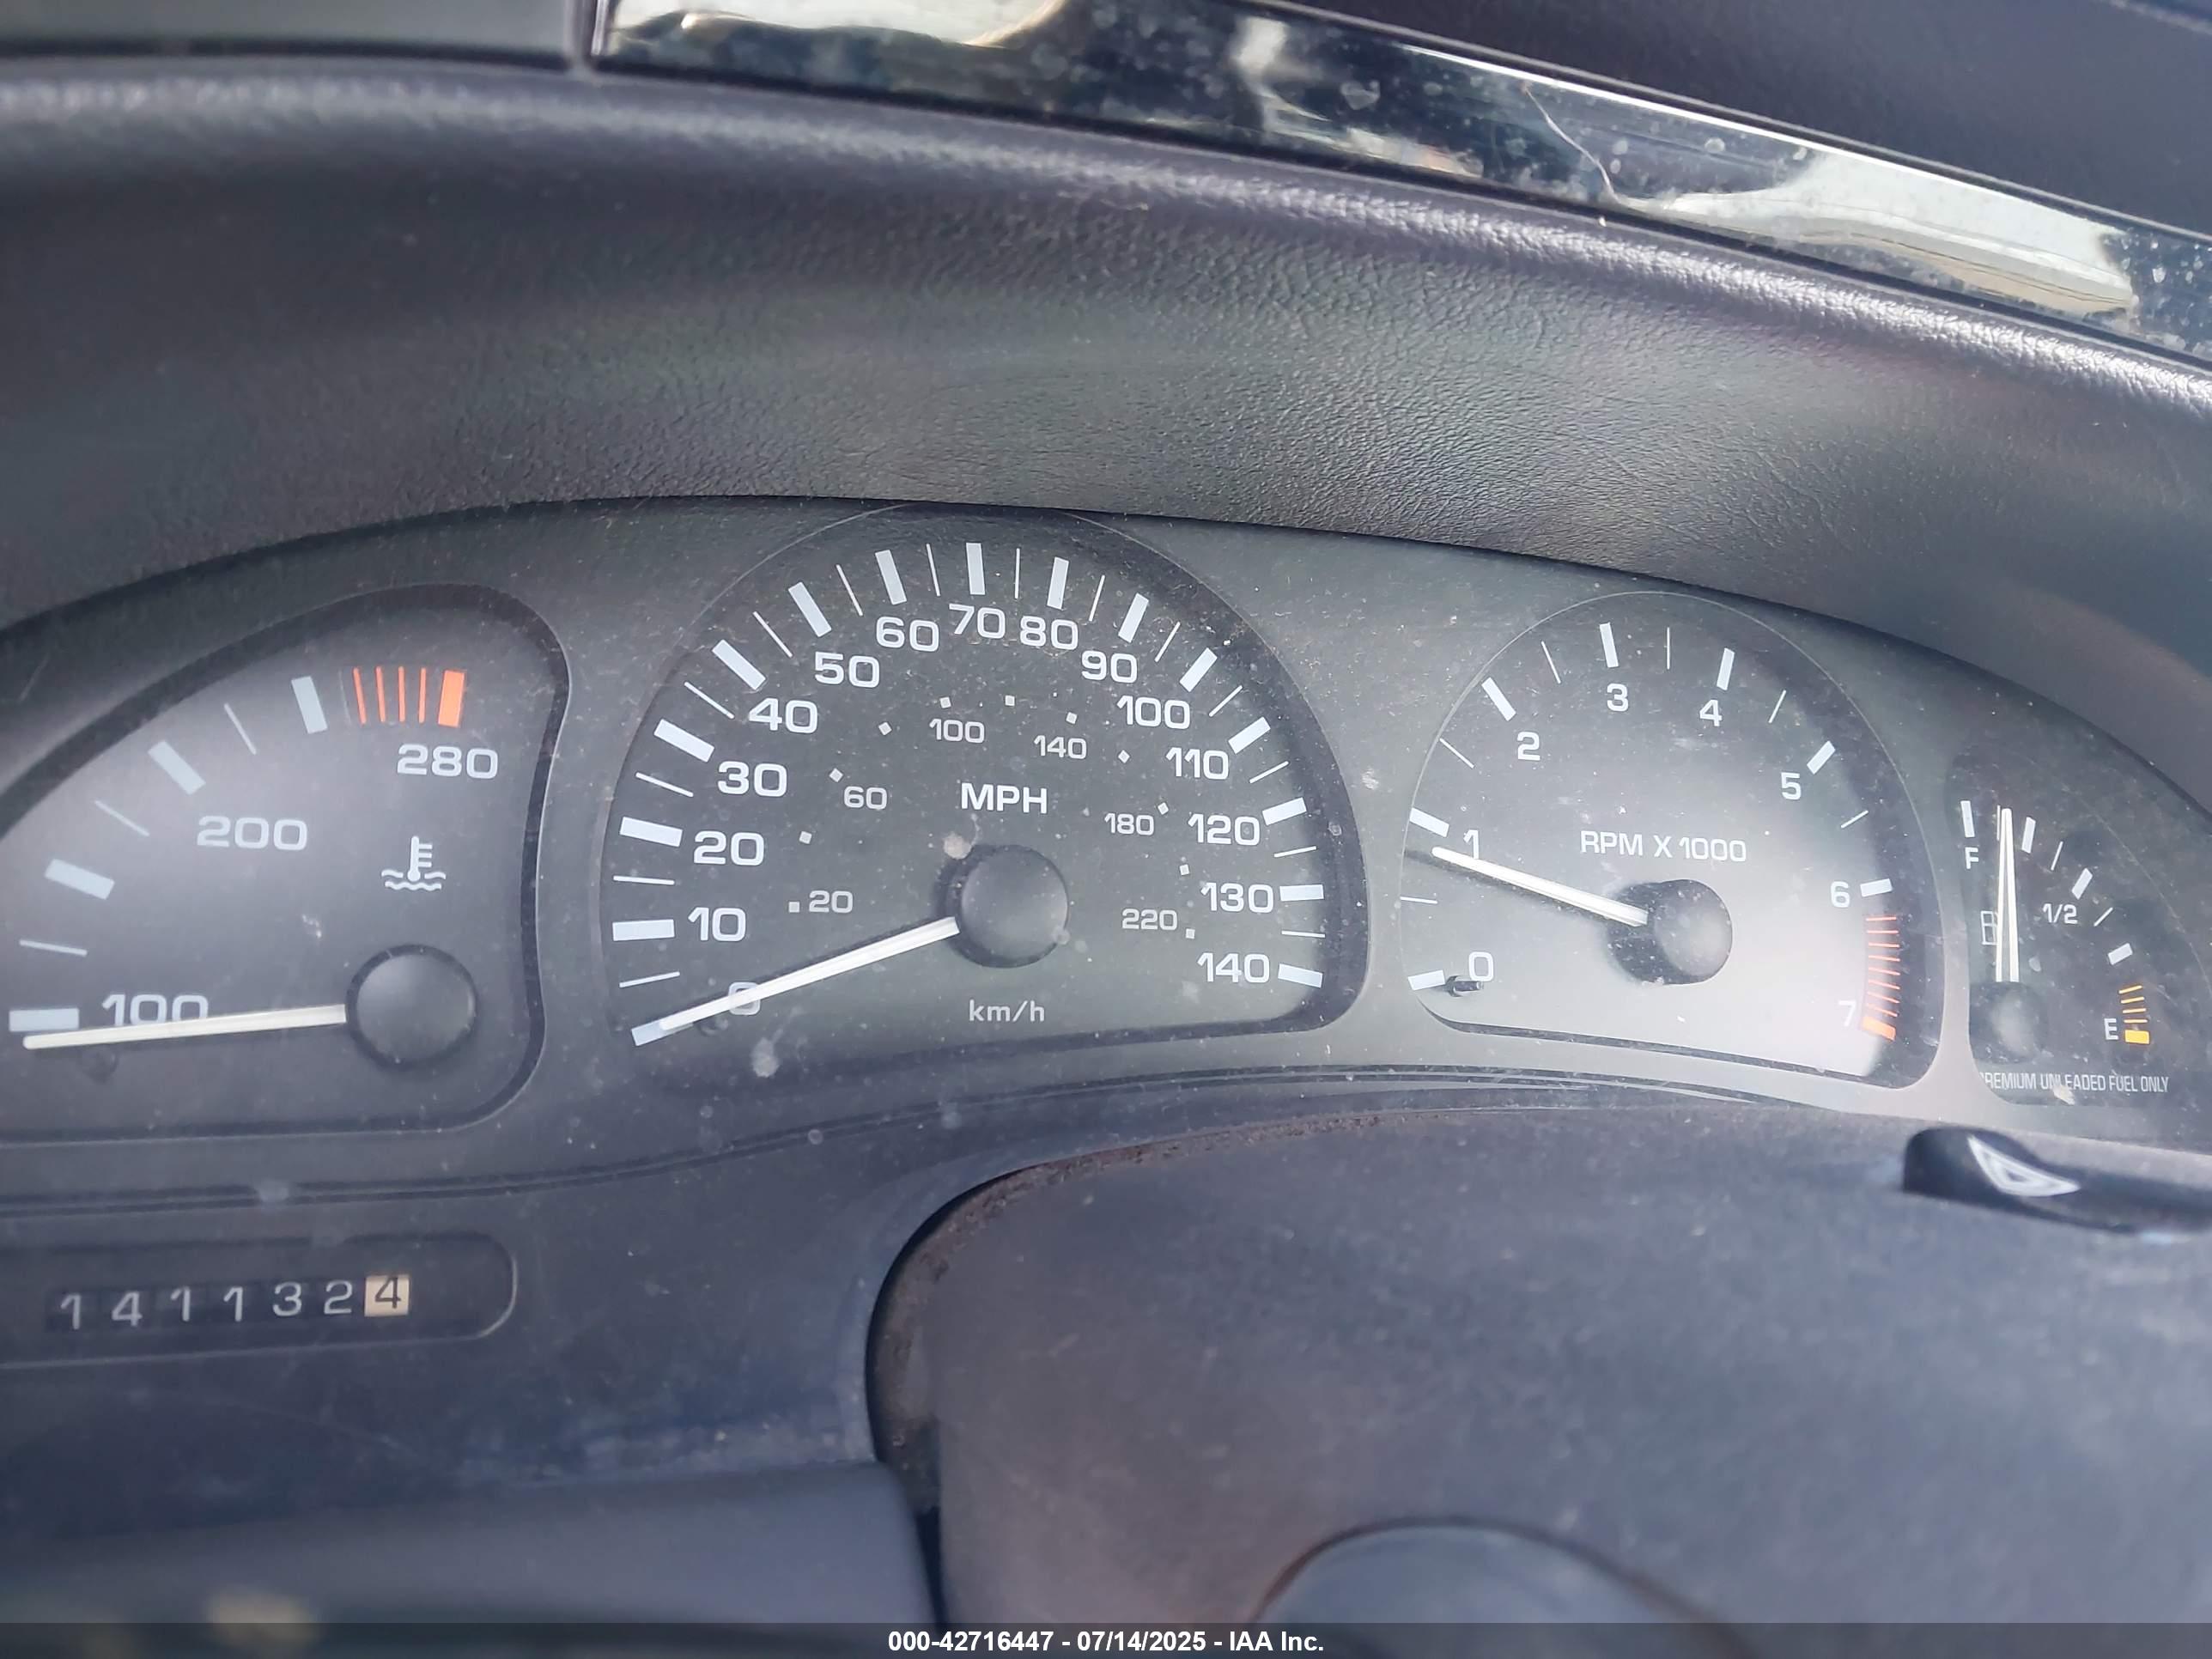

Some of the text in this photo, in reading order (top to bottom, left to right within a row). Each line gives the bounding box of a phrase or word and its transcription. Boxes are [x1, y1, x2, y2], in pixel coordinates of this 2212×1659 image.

[876, 617, 939, 653] 60
[949, 604, 1006, 639] 70
[1020, 616, 1079, 650] 80
[815, 651, 880, 689] 50
[1081, 651, 1138, 684] 90
[1117, 696, 1191, 730] 100
[1607, 684, 1629, 711] 3
[1699, 699, 1723, 726] 4
[748, 698, 818, 734] 40
[929, 718, 985, 744] 100
[396, 743, 499, 780] 280
[1034, 735, 1087, 759] 140
[1516, 732, 1540, 761] 2
[1166, 747, 1230, 781] 110
[716, 761, 788, 799] 30
[1780, 772, 1802, 800] 5
[843, 787, 888, 811] 60
[960, 782, 1048, 813] MPH
[197, 815, 308, 852] 200
[1104, 812, 1155, 836] 180
[1188, 813, 1261, 846] 120
[692, 830, 766, 866] 20
[1462, 830, 1480, 860] 1
[1580, 830, 1747, 862] RPM X 1000
[1965, 847, 1979, 870] F
[809, 890, 854, 914] 20
[1202, 882, 1274, 914] 130
[1830, 881, 1850, 908] 6
[687, 907, 747, 942] 10
[1121, 909, 1178, 931] 220
[2042, 903, 2078, 925] 1/2
[1198, 952, 1271, 984] 140
[1468, 951, 1495, 983] 0
[101, 994, 209, 1027] 100
[968, 1000, 1046, 1023] km/h
[1838, 1000, 1858, 1026] 7
[2104, 1018, 2119, 1041] E
[2109, 1075, 2138, 1092] FUEL
[2141, 1076, 2170, 1092] ONLY
